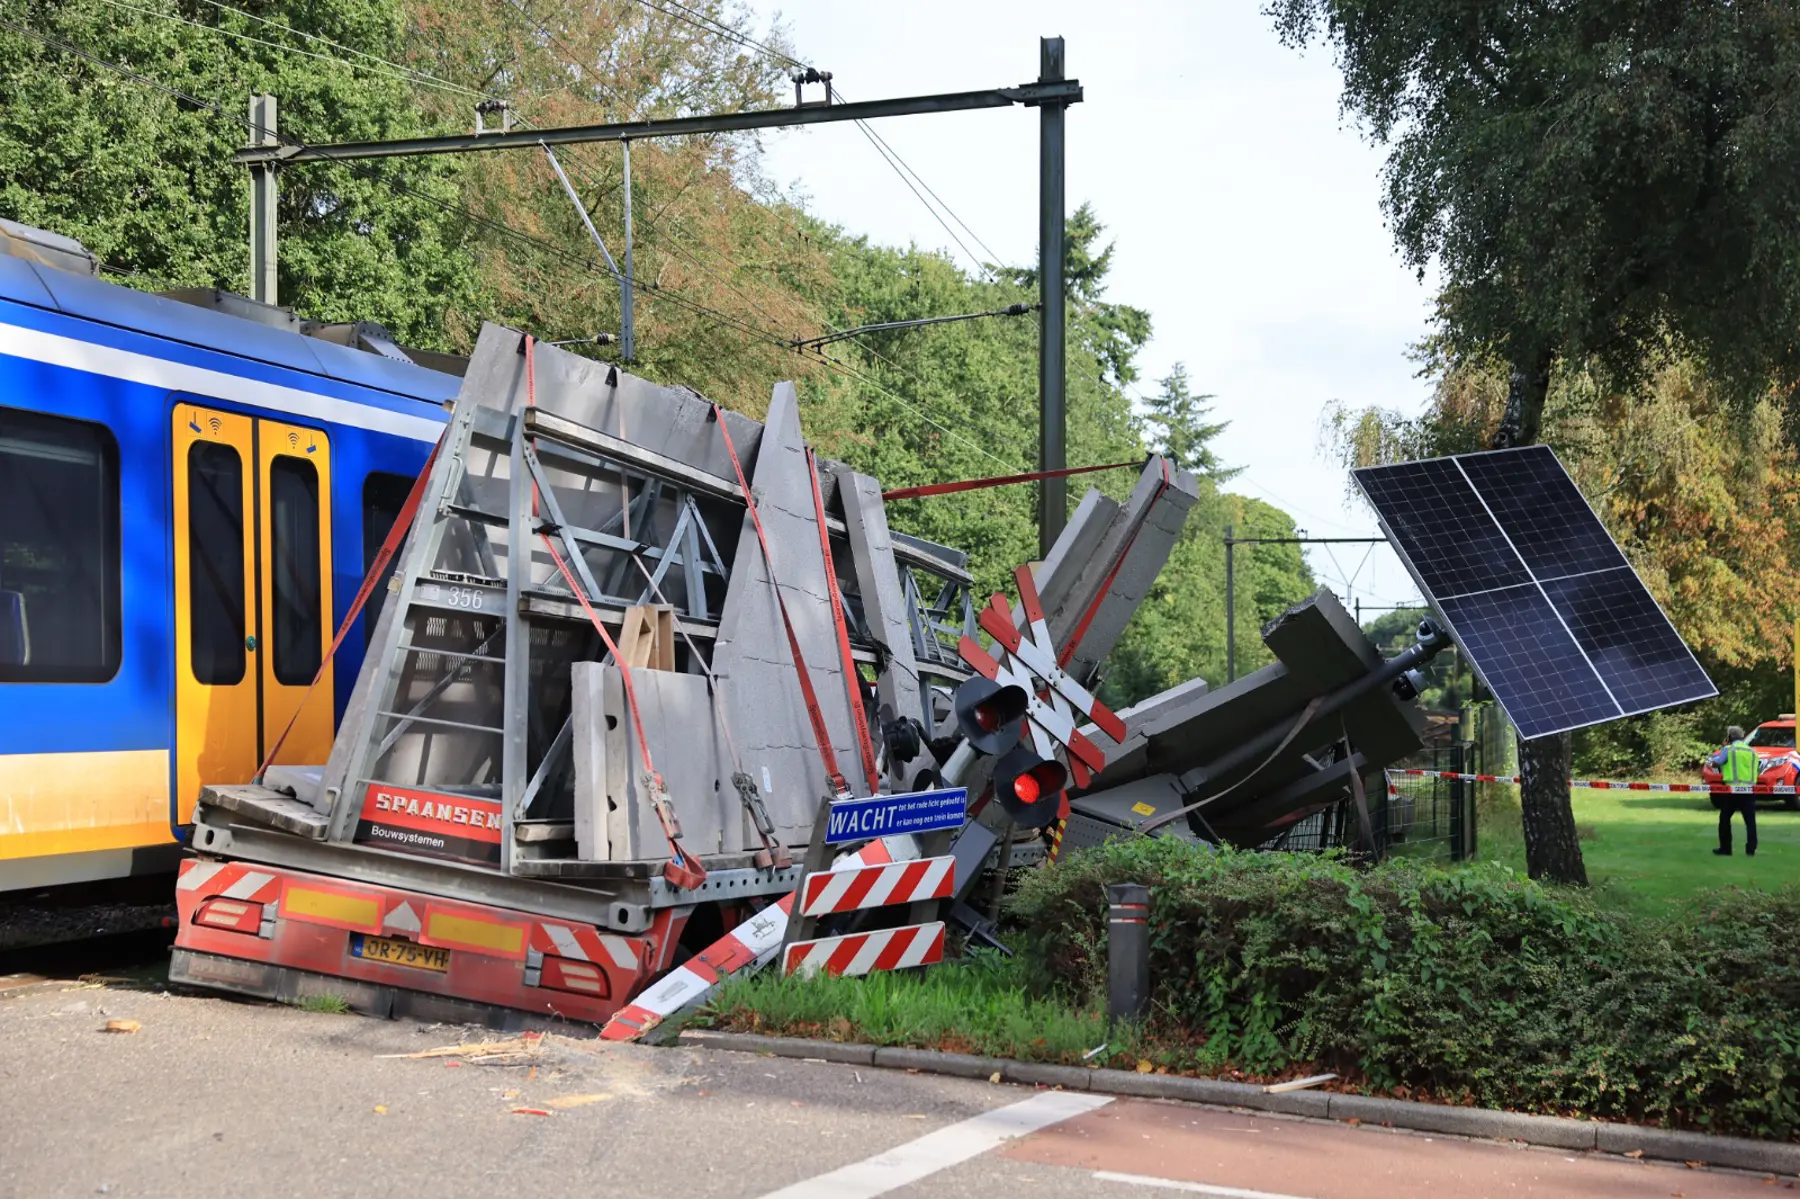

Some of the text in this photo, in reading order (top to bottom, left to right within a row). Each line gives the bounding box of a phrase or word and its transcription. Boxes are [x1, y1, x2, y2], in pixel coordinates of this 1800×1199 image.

[448, 586, 483, 609] 356
[376, 792, 501, 831] SPAANSEN
[830, 806, 898, 835] WACHT
[371, 825, 445, 848] Bouwsystemen
[368, 940, 446, 967] OR-75-VH
